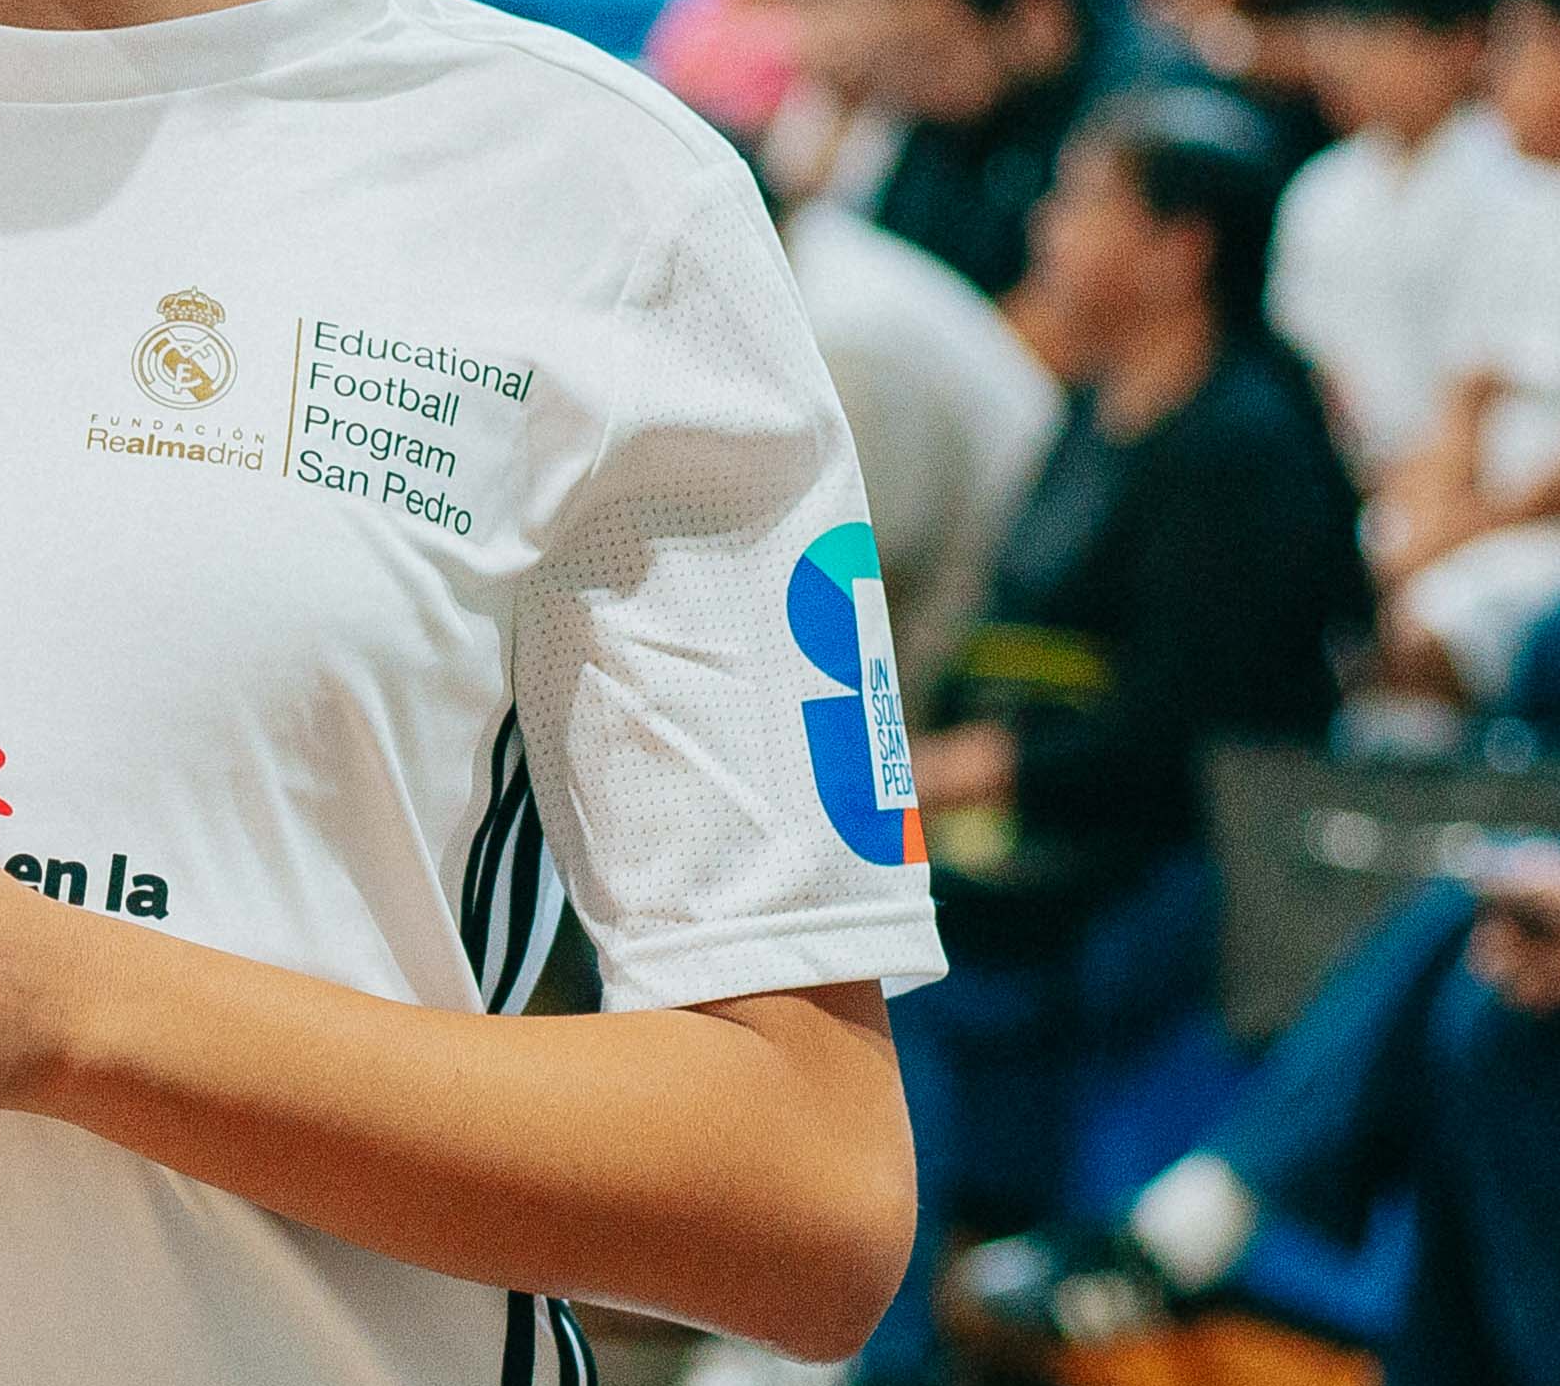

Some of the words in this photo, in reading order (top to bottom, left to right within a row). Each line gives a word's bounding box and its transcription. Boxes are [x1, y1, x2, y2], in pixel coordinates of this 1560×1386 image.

[308, 362, 460, 426] Football
[314, 321, 534, 403] Educational
[86, 427, 264, 471] Realmadrid
[91, 413, 265, 445] FUNDACIÓN
[303, 404, 456, 477] Program
[297, 450, 370, 496] San
[382, 471, 472, 536] Pedro
[870, 658, 889, 691] UN
[878, 728, 906, 761] SAN
[106, 854, 169, 920] la
